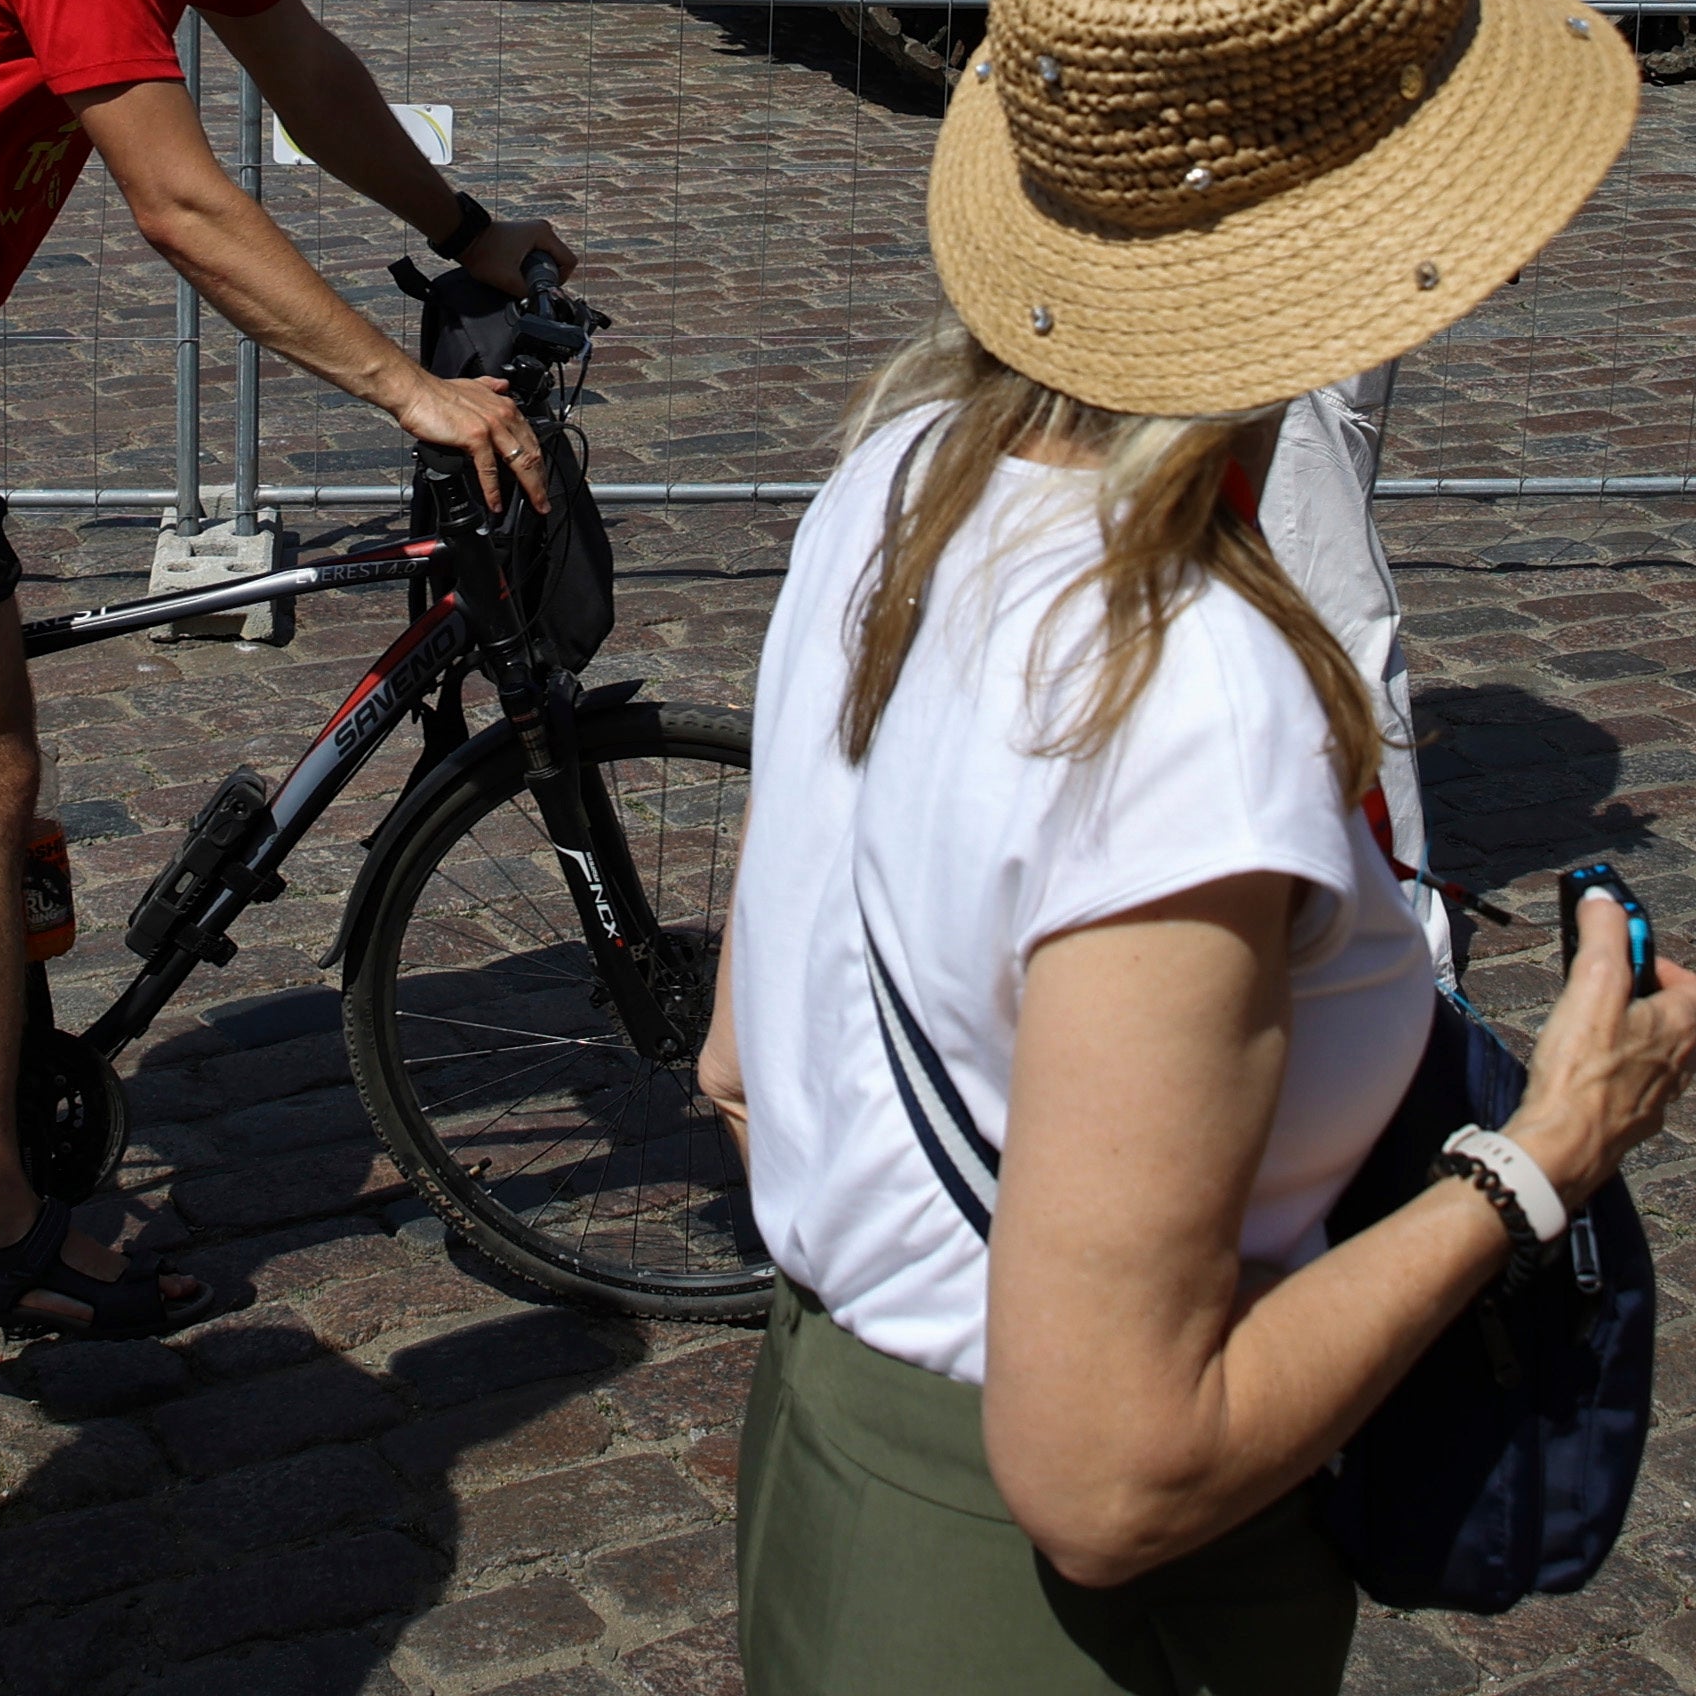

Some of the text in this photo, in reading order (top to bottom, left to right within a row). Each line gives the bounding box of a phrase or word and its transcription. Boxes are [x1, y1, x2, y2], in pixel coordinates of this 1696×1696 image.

[296, 562, 383, 584] EVEREST
[334, 624, 457, 758] SAVENO
[589, 884, 621, 938] NCX
[416, 1166, 476, 1229] KENDA
